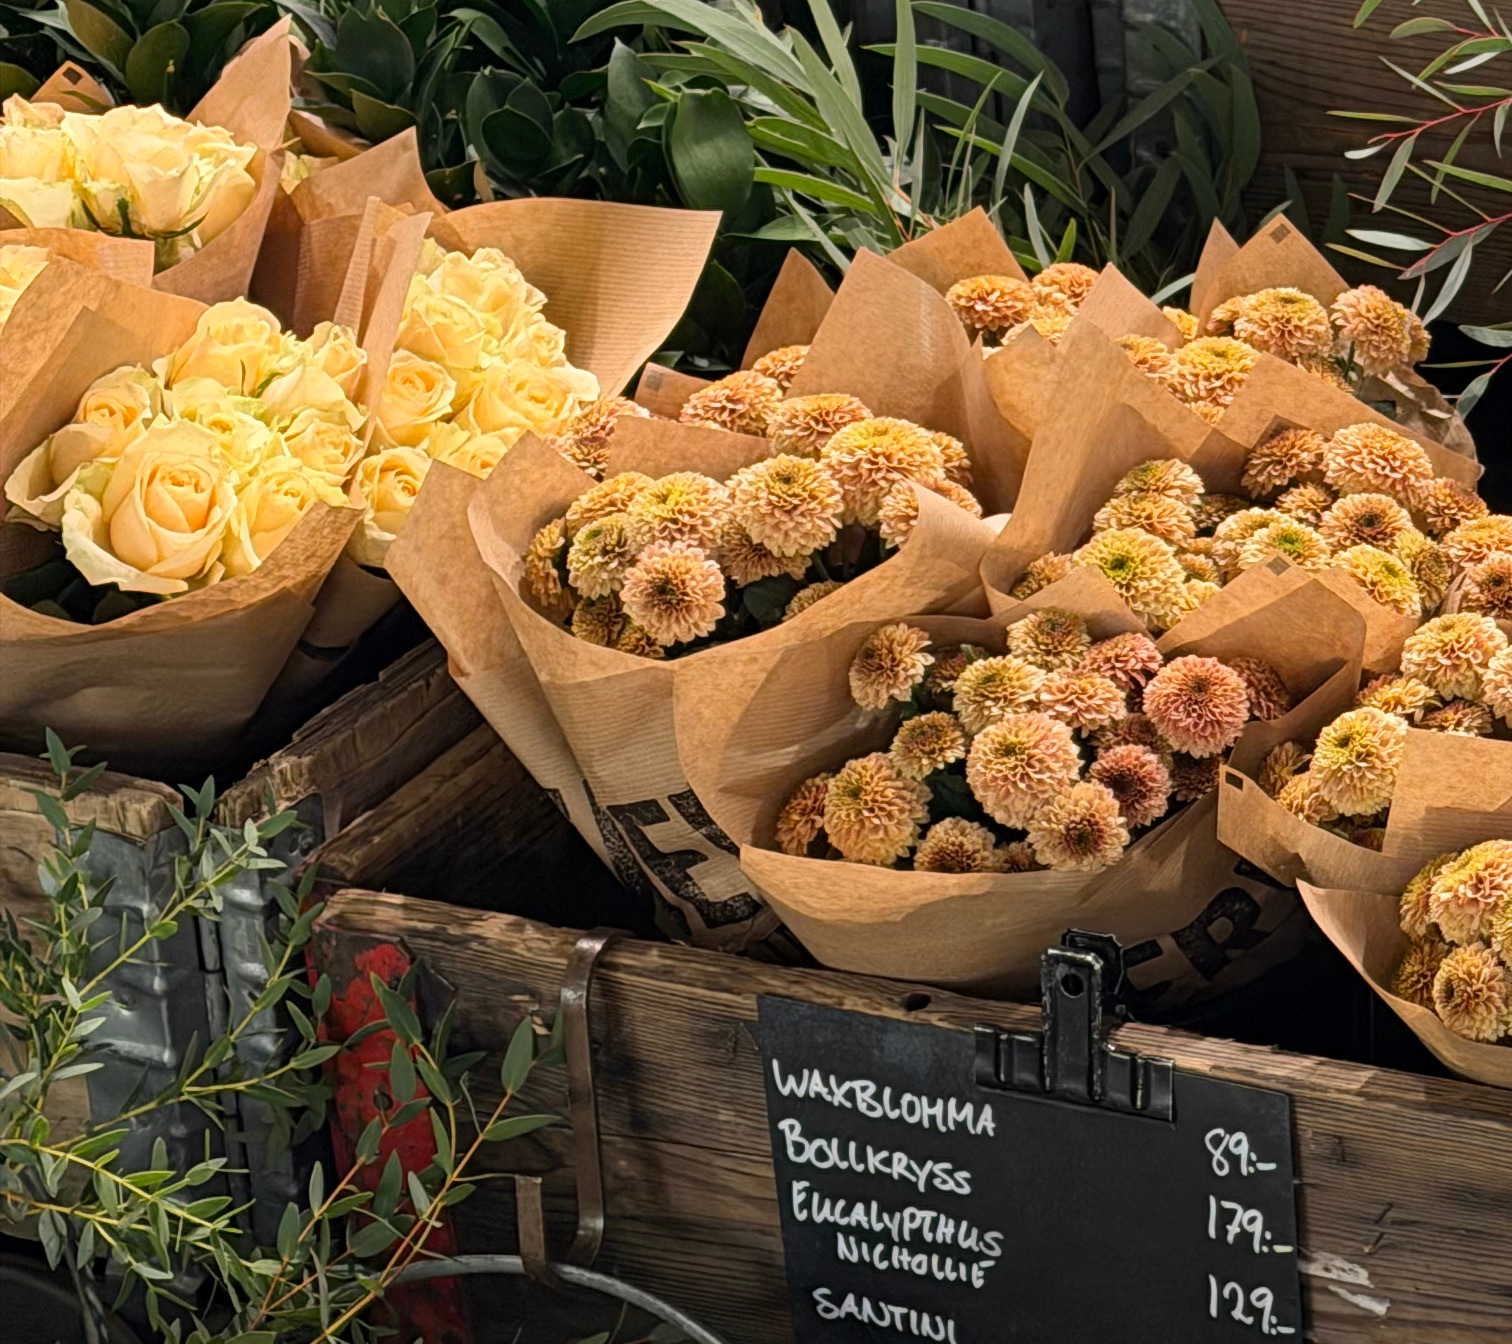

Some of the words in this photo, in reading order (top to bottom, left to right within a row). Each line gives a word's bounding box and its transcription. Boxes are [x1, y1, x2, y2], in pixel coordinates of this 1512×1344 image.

[772, 1058, 996, 1137] WAXBLOMMA
[777, 1118, 972, 1195] BOLLKRYSS
[791, 1180, 1004, 1257] EUCALYPTHUS
[836, 1232, 996, 1289] NICHOLLIE
